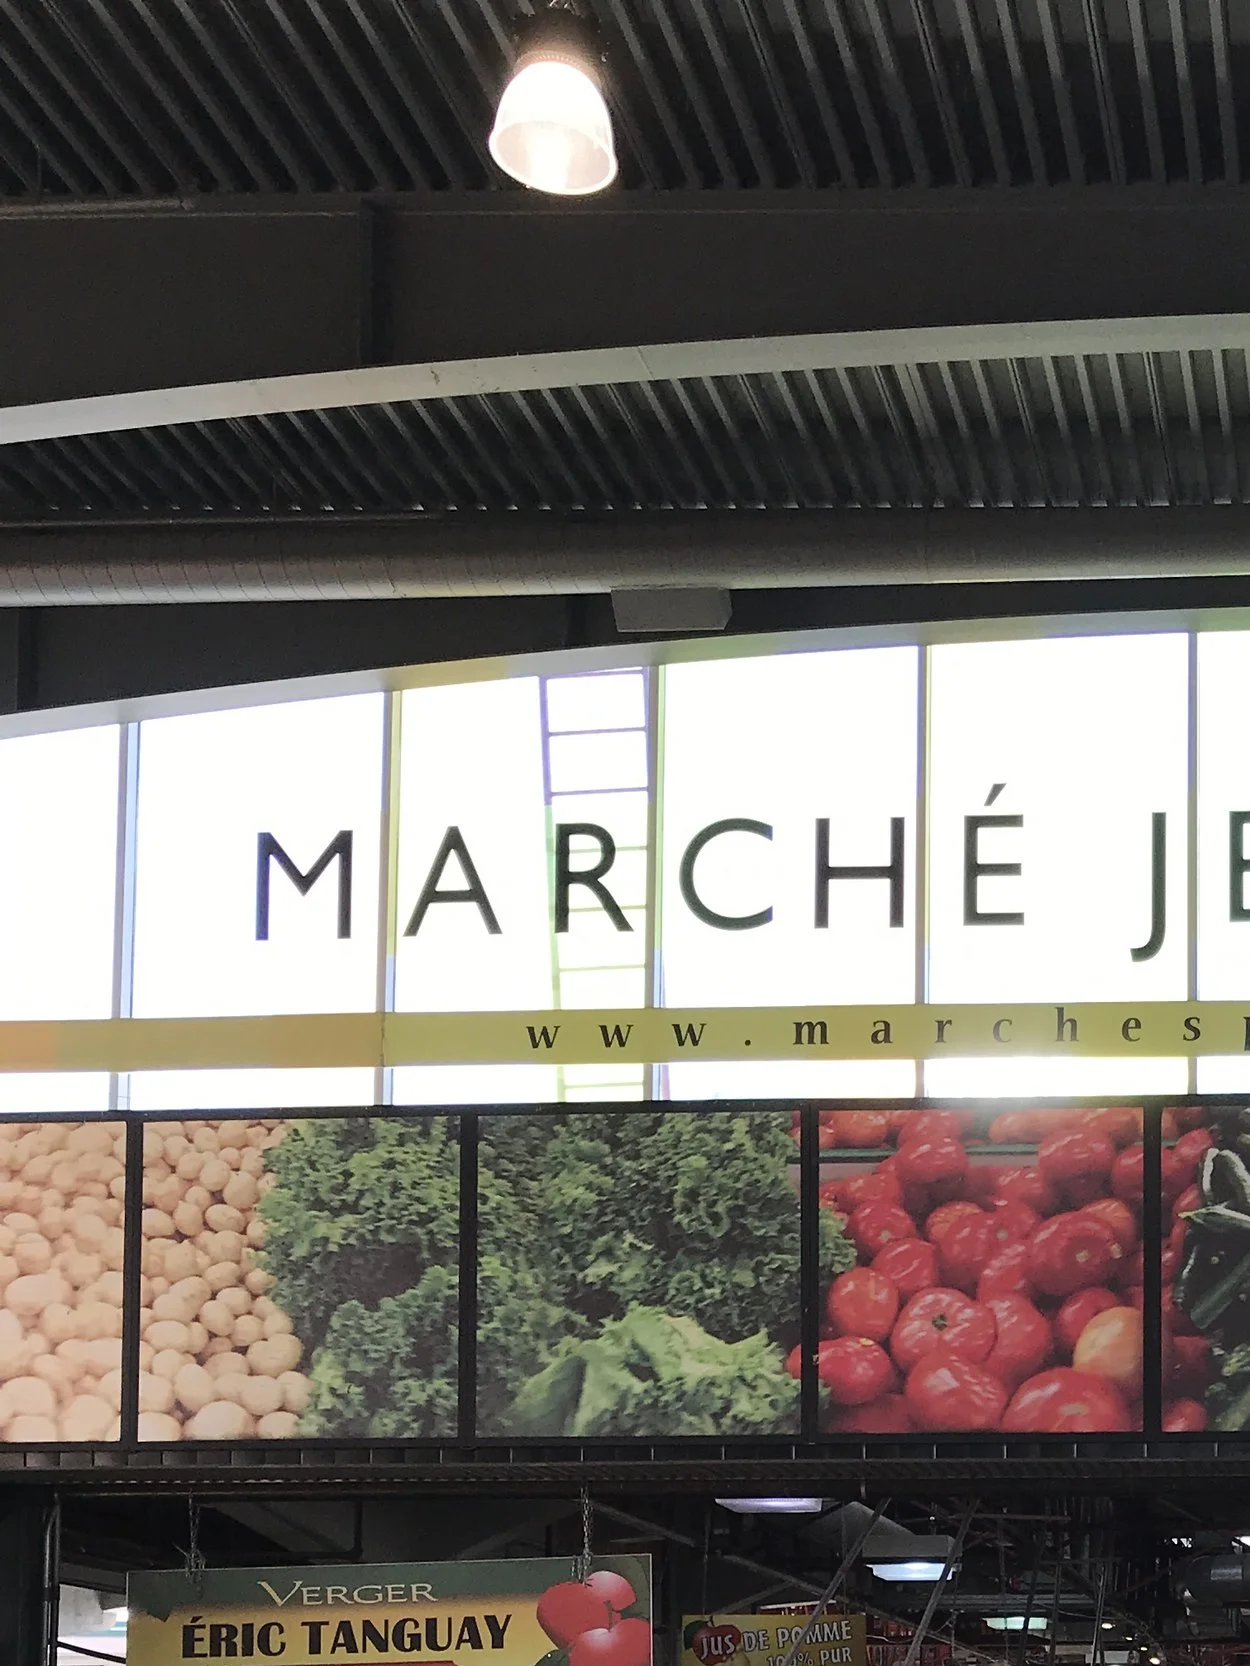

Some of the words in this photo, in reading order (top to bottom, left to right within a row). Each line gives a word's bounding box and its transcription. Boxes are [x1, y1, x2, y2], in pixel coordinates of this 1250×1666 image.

[256, 783, 1025, 941] MARCHÉ
[181, 1616, 286, 1659] ÉRIC
[301, 1614, 513, 1656] TANGUAY
[700, 1634, 737, 1660] JUS
[742, 1630, 770, 1653] DE
[820, 1647, 853, 1666] PUR
